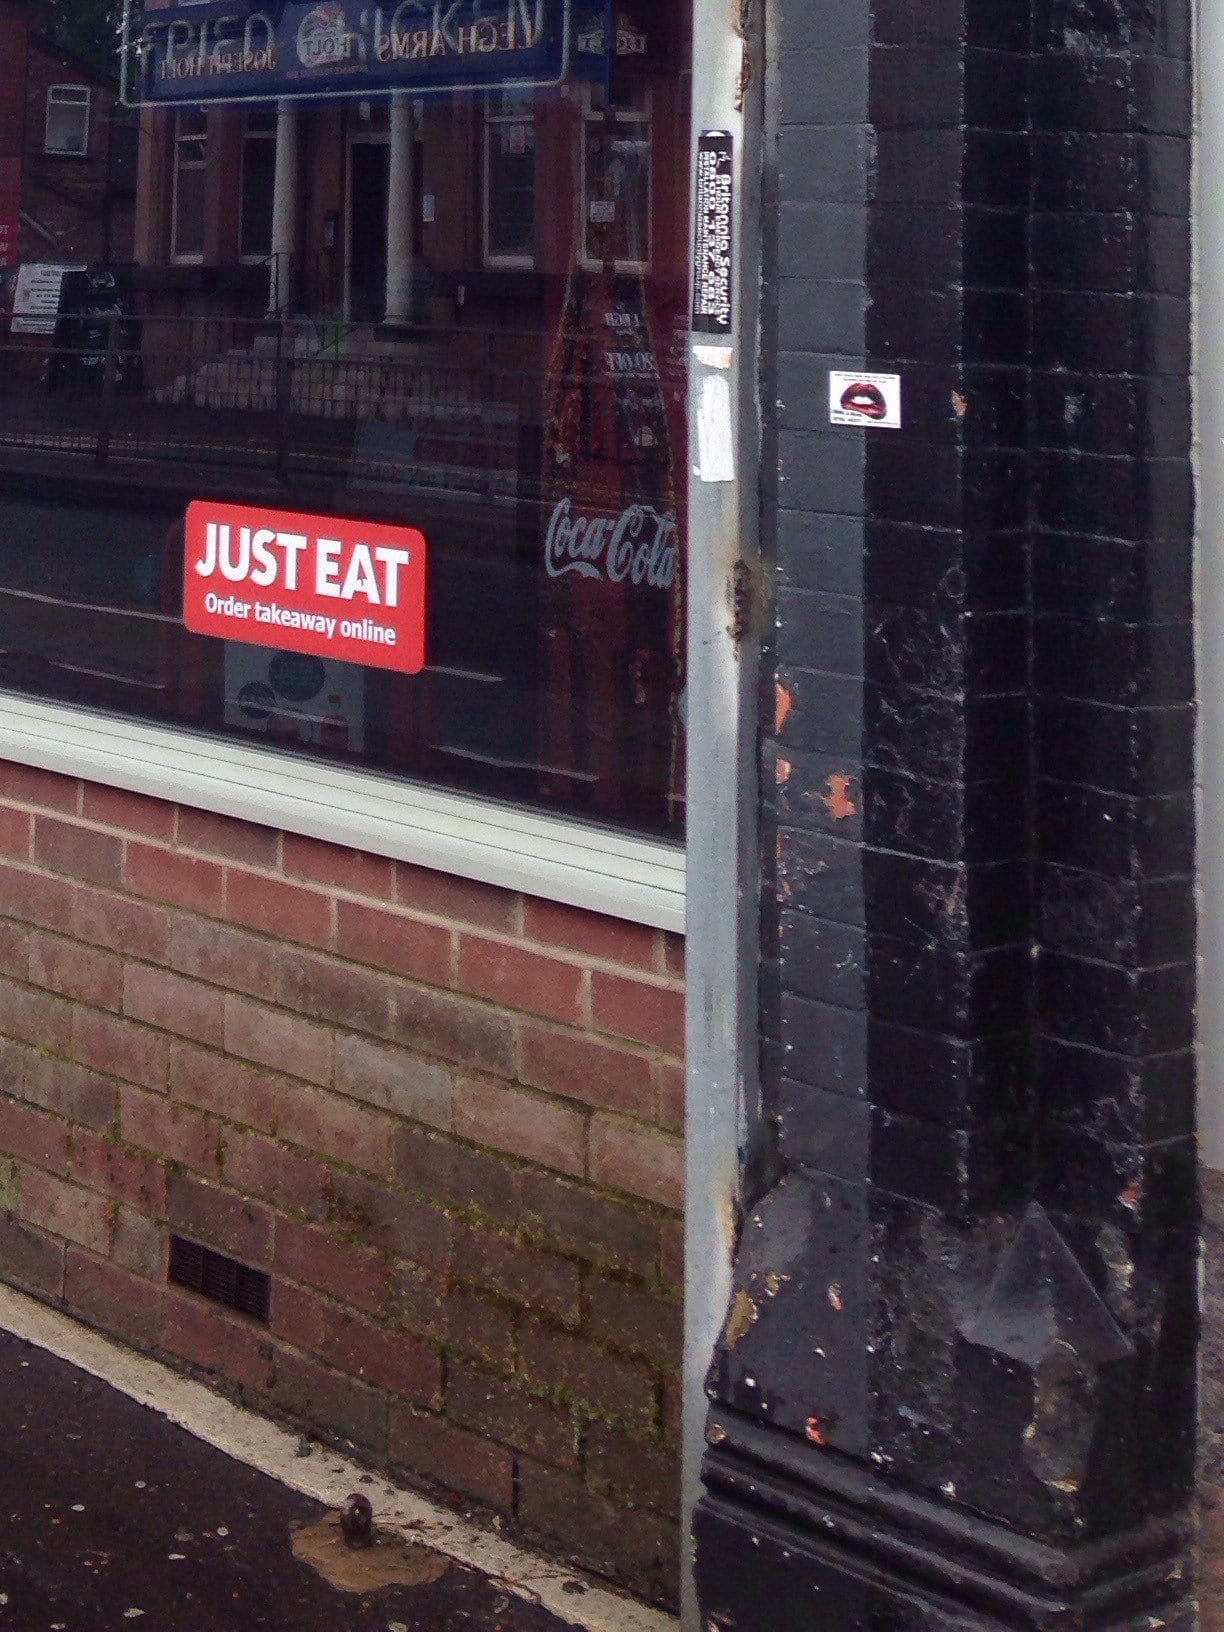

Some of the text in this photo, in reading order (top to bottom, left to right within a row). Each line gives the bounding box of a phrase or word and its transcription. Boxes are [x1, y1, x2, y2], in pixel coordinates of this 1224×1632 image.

[716, 174, 732, 325] Britannia Security
[194, 522, 410, 608] JUST EAT
[545, 497, 677, 590] Coca-Cola
[205, 594, 396, 646] Order takeaway online
